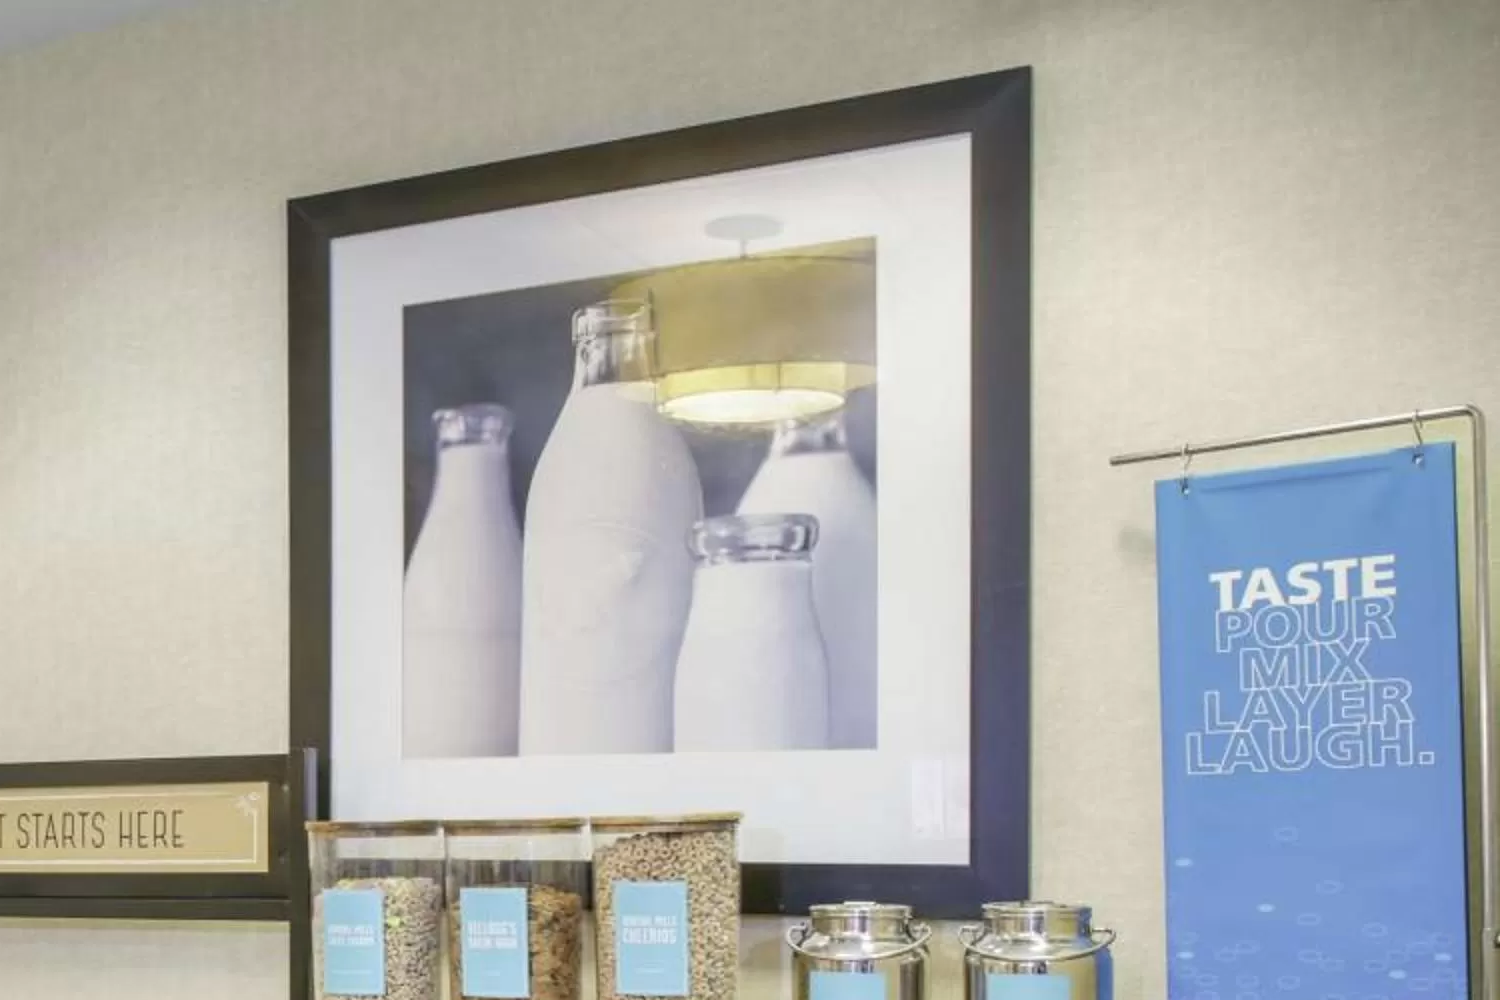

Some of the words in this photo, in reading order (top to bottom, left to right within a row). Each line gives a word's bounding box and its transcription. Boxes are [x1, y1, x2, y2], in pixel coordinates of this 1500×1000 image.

[1209, 554, 1396, 612] TASTE
[1215, 595, 1396, 653] POUR
[1240, 637, 1372, 691] MIX
[1204, 677, 1415, 735] LAYER
[1186, 721, 1436, 776] LAUGH.
[16, 811, 106, 849] STARTS
[119, 809, 185, 849] HERE
